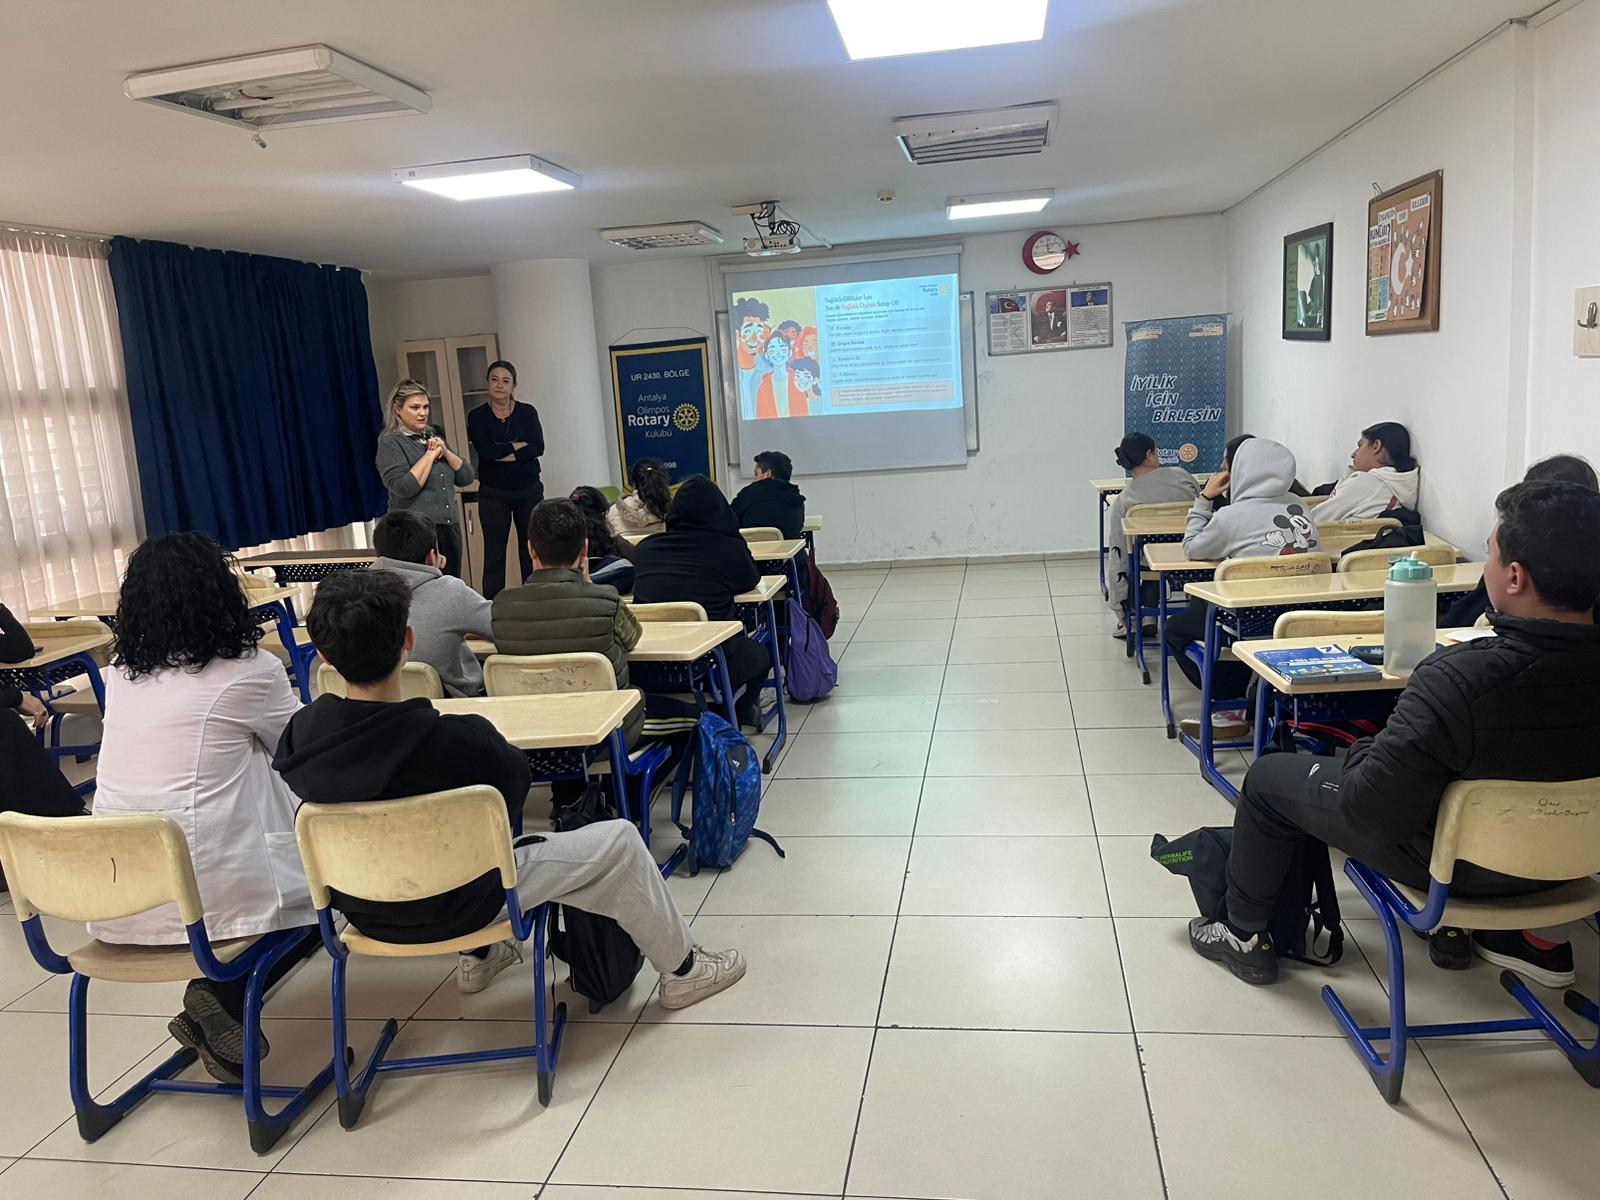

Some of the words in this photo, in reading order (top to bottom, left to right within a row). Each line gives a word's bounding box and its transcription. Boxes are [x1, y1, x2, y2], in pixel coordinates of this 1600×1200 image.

[664, 369, 690, 379] BÖLGE
[1130, 373, 1177, 391] İYİLİK
[638, 393, 667, 403] Antalya
[1145, 392, 1179, 408] İÇİN
[637, 406, 670, 415] Olimpos
[1152, 407, 1221, 423] BİRLEŞİN
[627, 414, 670, 427] Rotary
[645, 429, 672, 438] Kulübü
[1156, 448, 1179, 458] otary
